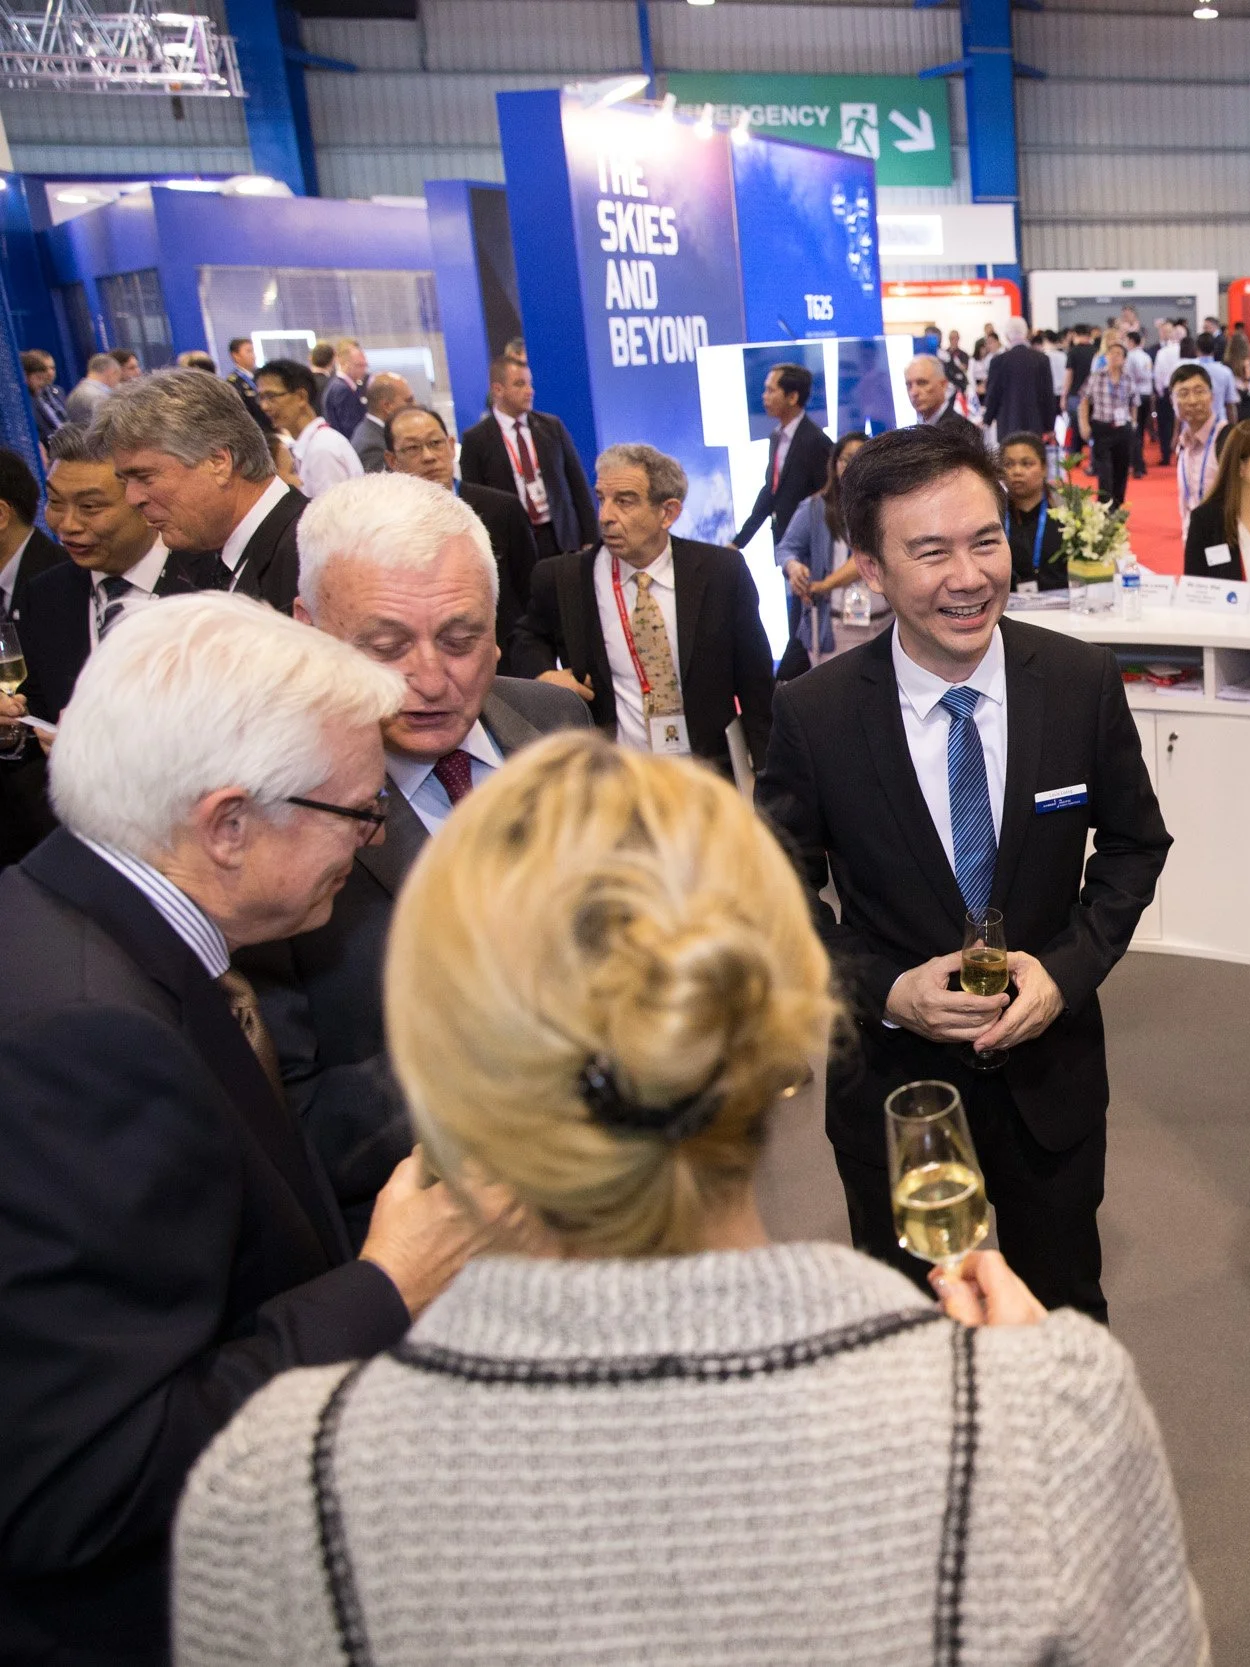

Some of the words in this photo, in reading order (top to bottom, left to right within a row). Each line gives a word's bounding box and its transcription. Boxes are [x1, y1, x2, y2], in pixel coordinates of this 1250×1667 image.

[597, 150, 649, 198] THE
[597, 199, 679, 256] SKIES
[605, 258, 659, 310] AND
[608, 314, 709, 367] BEYOND
